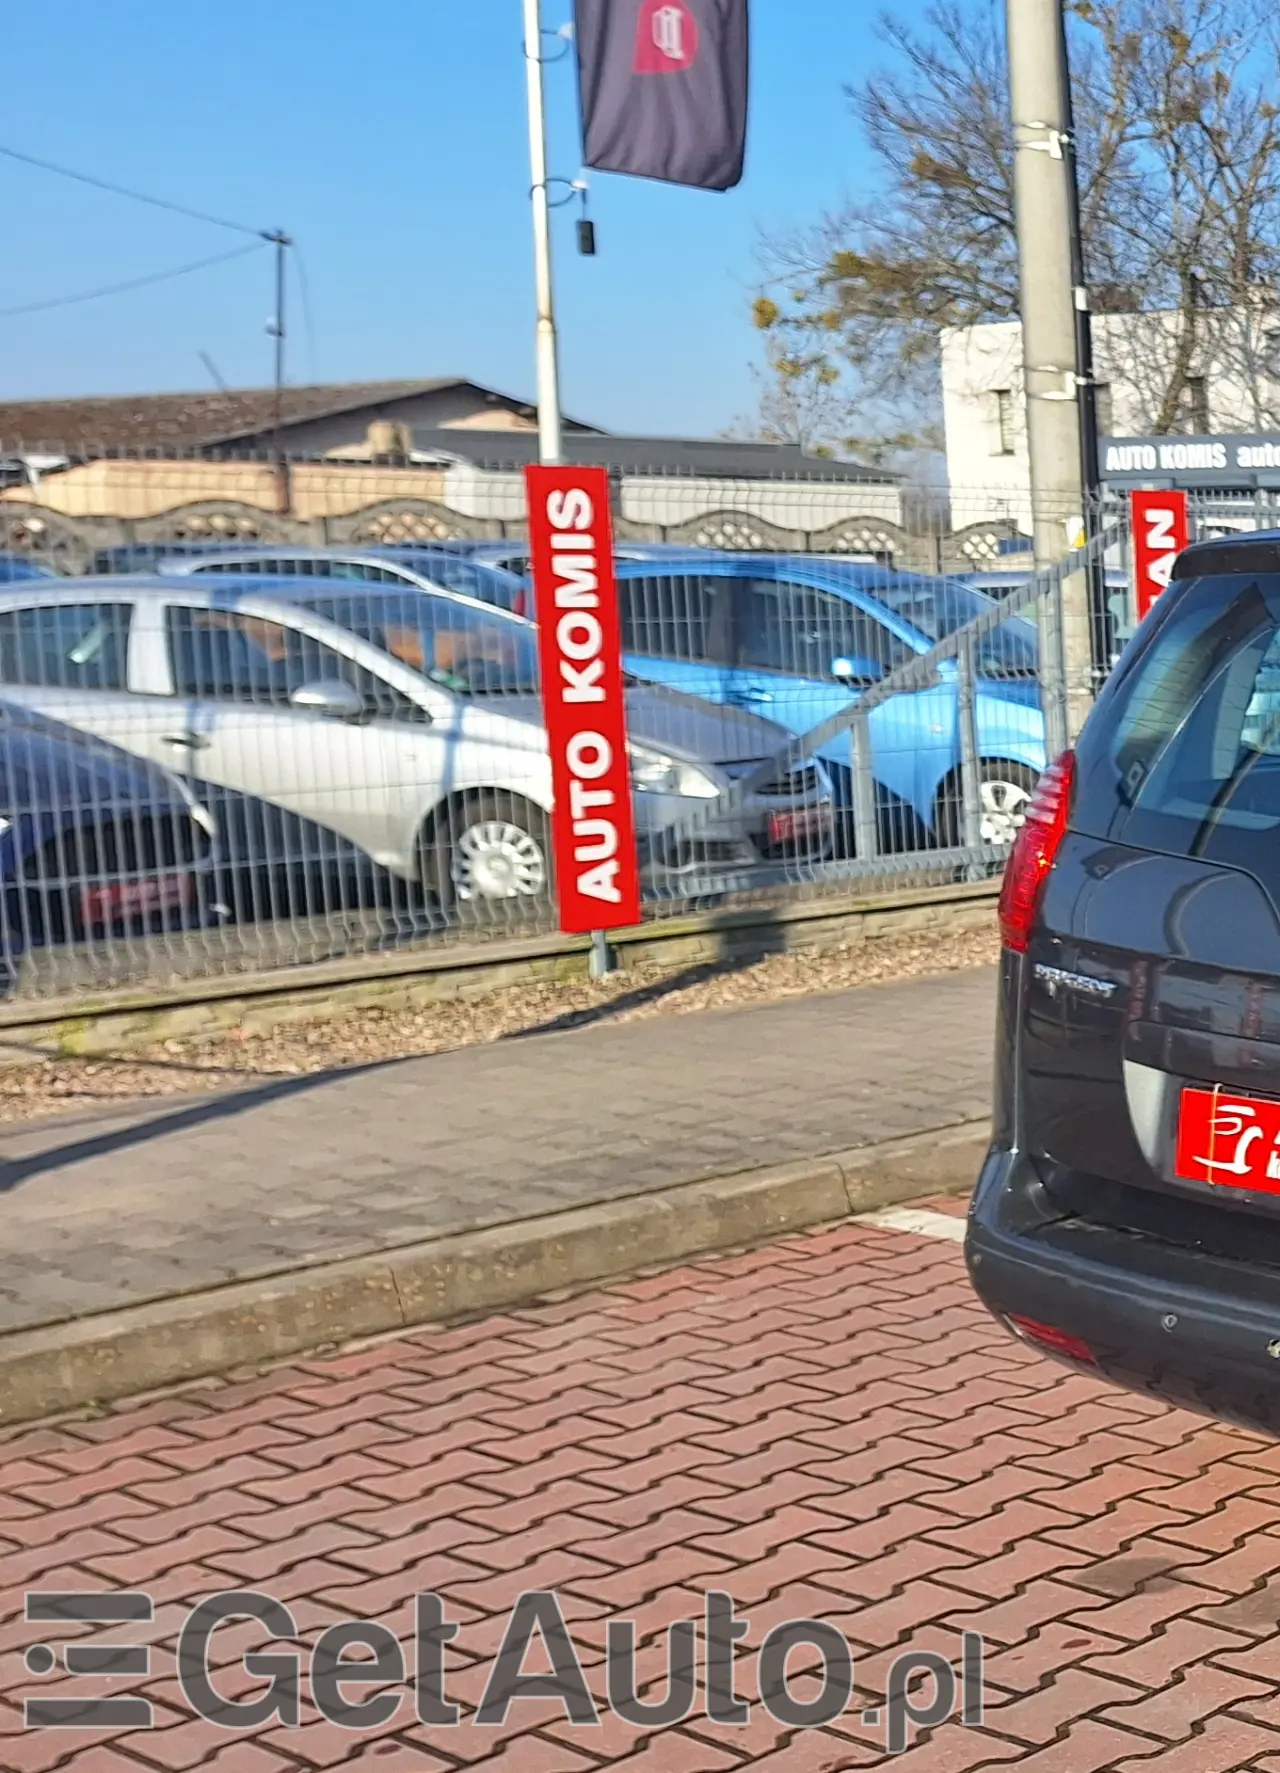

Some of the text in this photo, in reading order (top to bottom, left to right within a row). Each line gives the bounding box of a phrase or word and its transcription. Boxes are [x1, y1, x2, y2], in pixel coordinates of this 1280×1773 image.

[1106, 444, 1156, 471] AUTO
[1160, 442, 1228, 469] KOMIS
[546, 487, 623, 903] AUTO KOMIS
